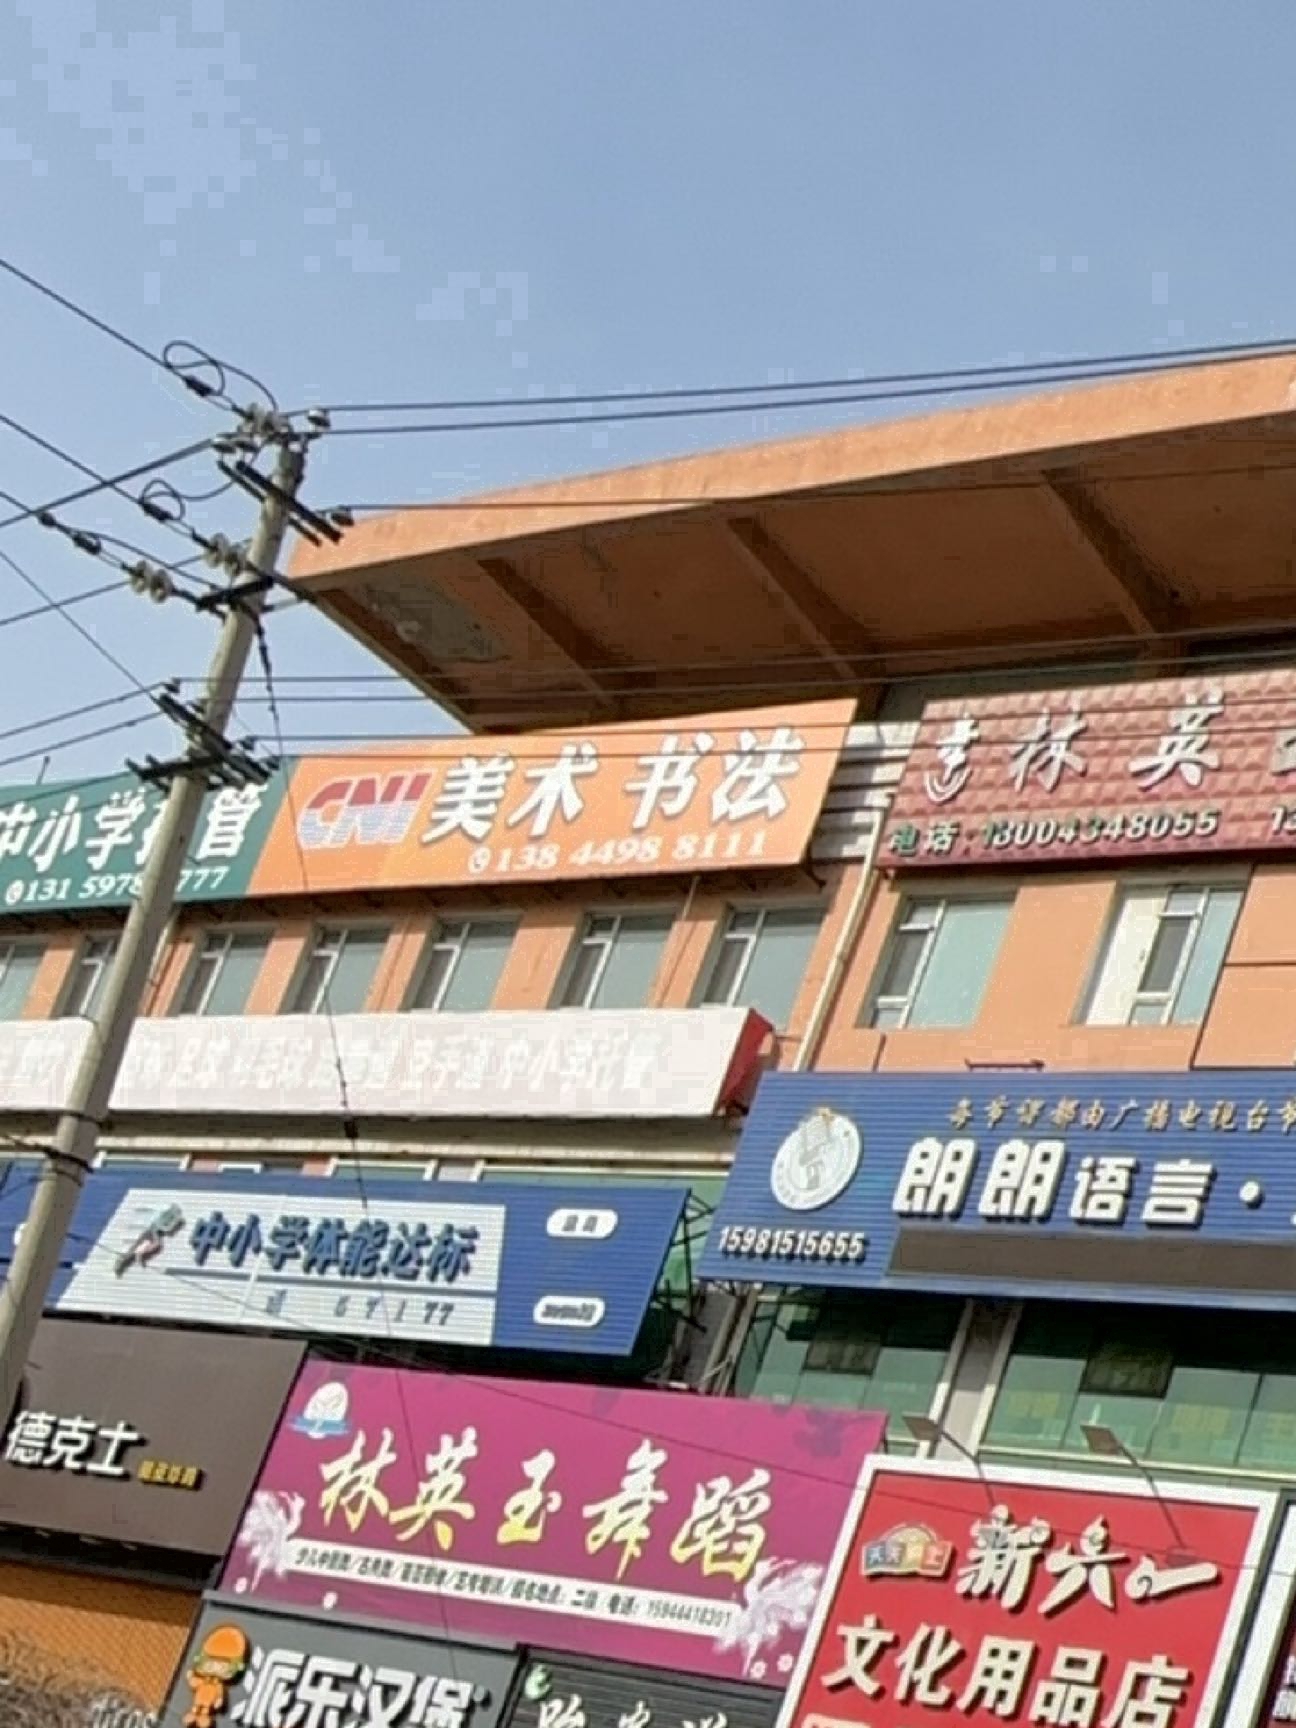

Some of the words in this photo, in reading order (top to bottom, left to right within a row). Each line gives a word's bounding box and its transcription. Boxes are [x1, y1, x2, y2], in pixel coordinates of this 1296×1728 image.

[0, 783, 268, 872] 中小学管
[499, 842, 560, 873] 138
[569, 835, 658, 863] 4498
[672, 831, 766, 859] 8111
[23, 878, 71, 900] 131
[190, 1211, 479, 1283] 中小学体能达标
[719, 1227, 866, 1259] 15981515655
[5, 1410, 141, 1476] 德克士
[320, 1426, 771, 1583] 林英玉舞蹈
